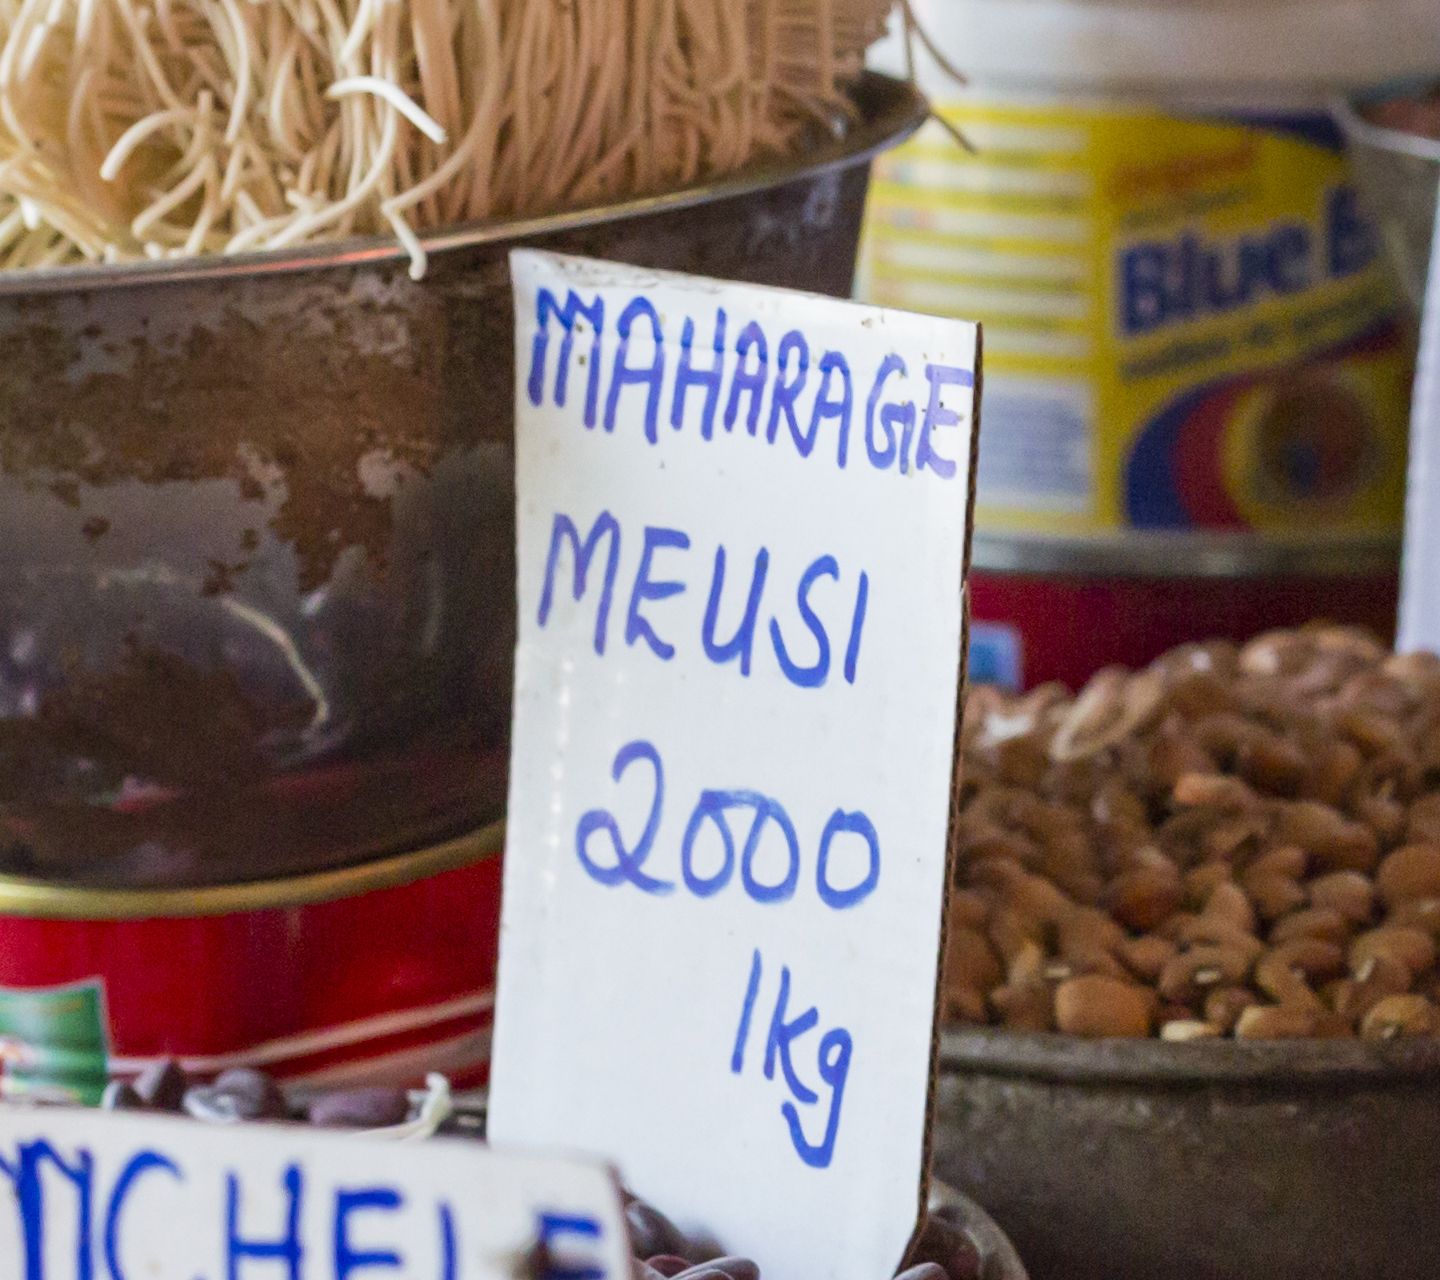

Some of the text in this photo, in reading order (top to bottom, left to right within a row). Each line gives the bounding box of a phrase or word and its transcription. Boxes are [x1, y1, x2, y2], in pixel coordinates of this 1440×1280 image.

[1122, 220, 1312, 340] Blue
[526, 285, 974, 478] MAHARAGE
[537, 511, 869, 689] MEUSI
[576, 740, 882, 909] 2000
[731, 948, 852, 1169] 1kg
